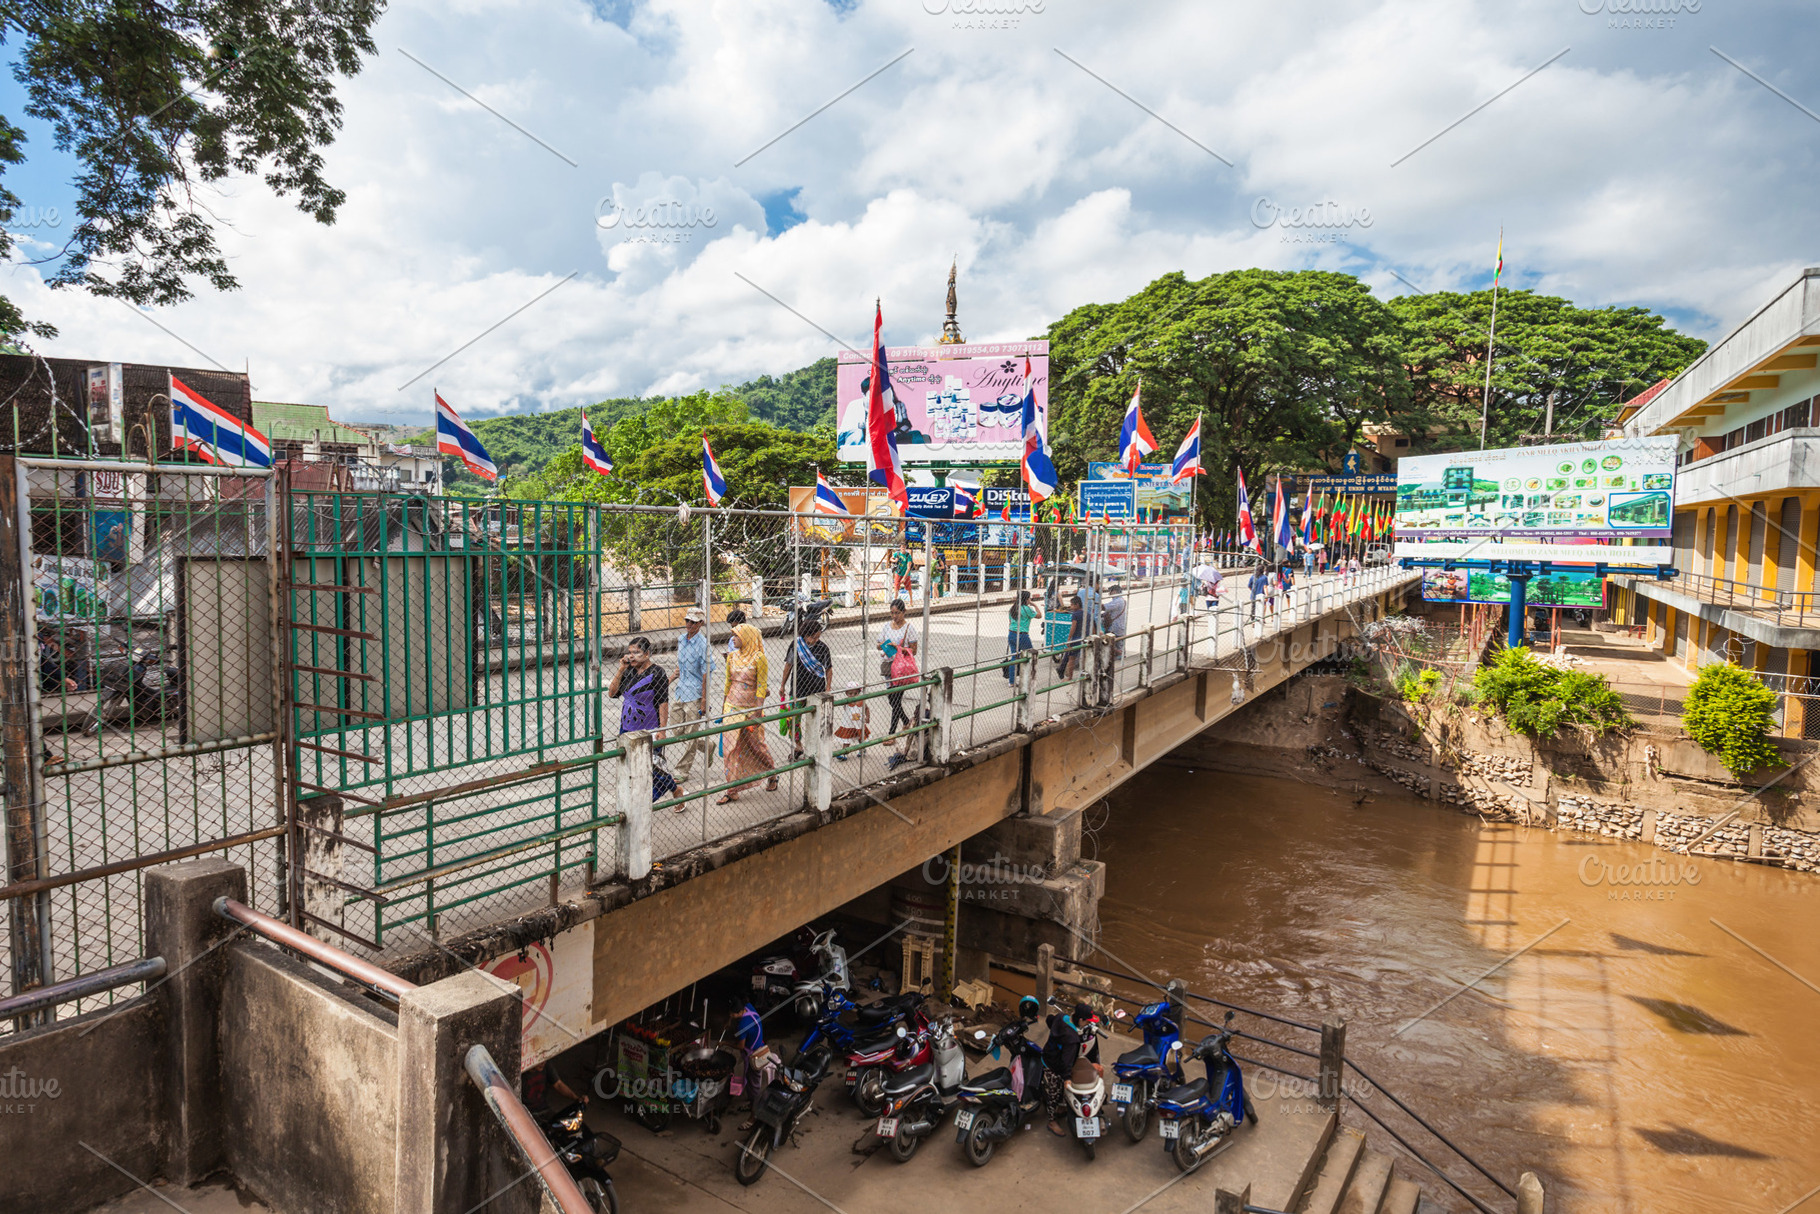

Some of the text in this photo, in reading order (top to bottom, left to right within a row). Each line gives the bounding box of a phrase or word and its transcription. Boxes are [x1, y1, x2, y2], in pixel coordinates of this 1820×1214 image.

[843, 352, 873, 360] Contac
[897, 376, 926, 384] Anytime
[966, 367, 1046, 396] Anytie
[908, 493, 948, 503] ZULEX
